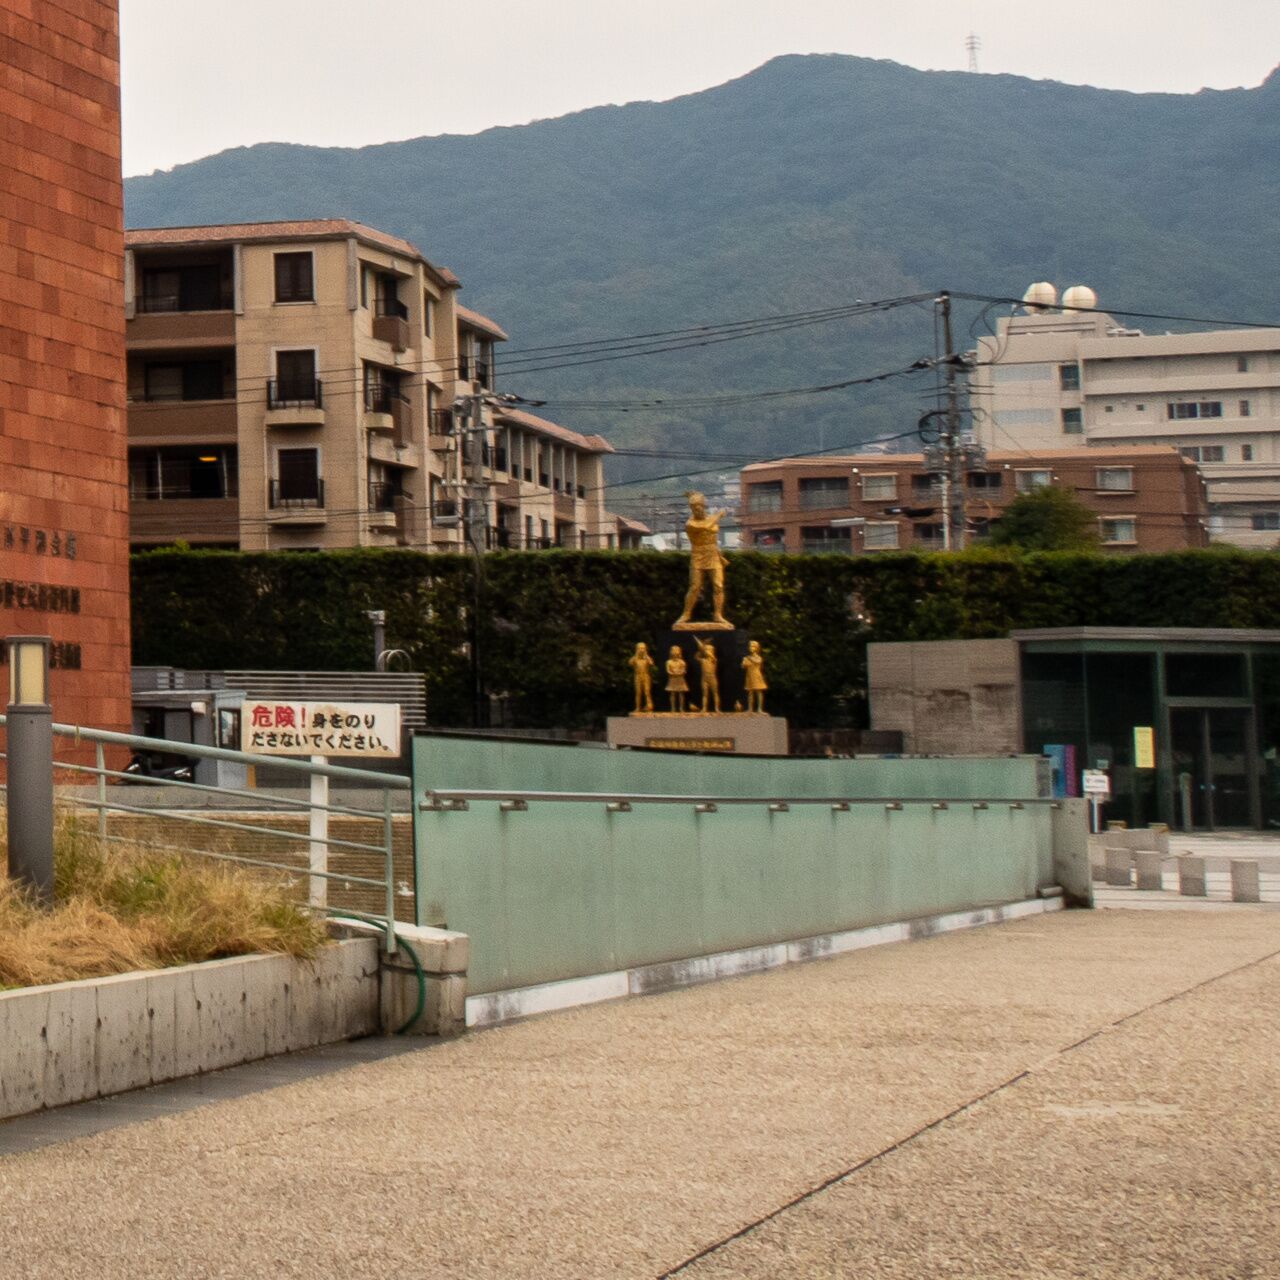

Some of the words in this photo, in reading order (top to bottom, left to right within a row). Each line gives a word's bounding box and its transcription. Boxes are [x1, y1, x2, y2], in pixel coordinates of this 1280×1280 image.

[251, 732, 389, 751] ださないでください。
